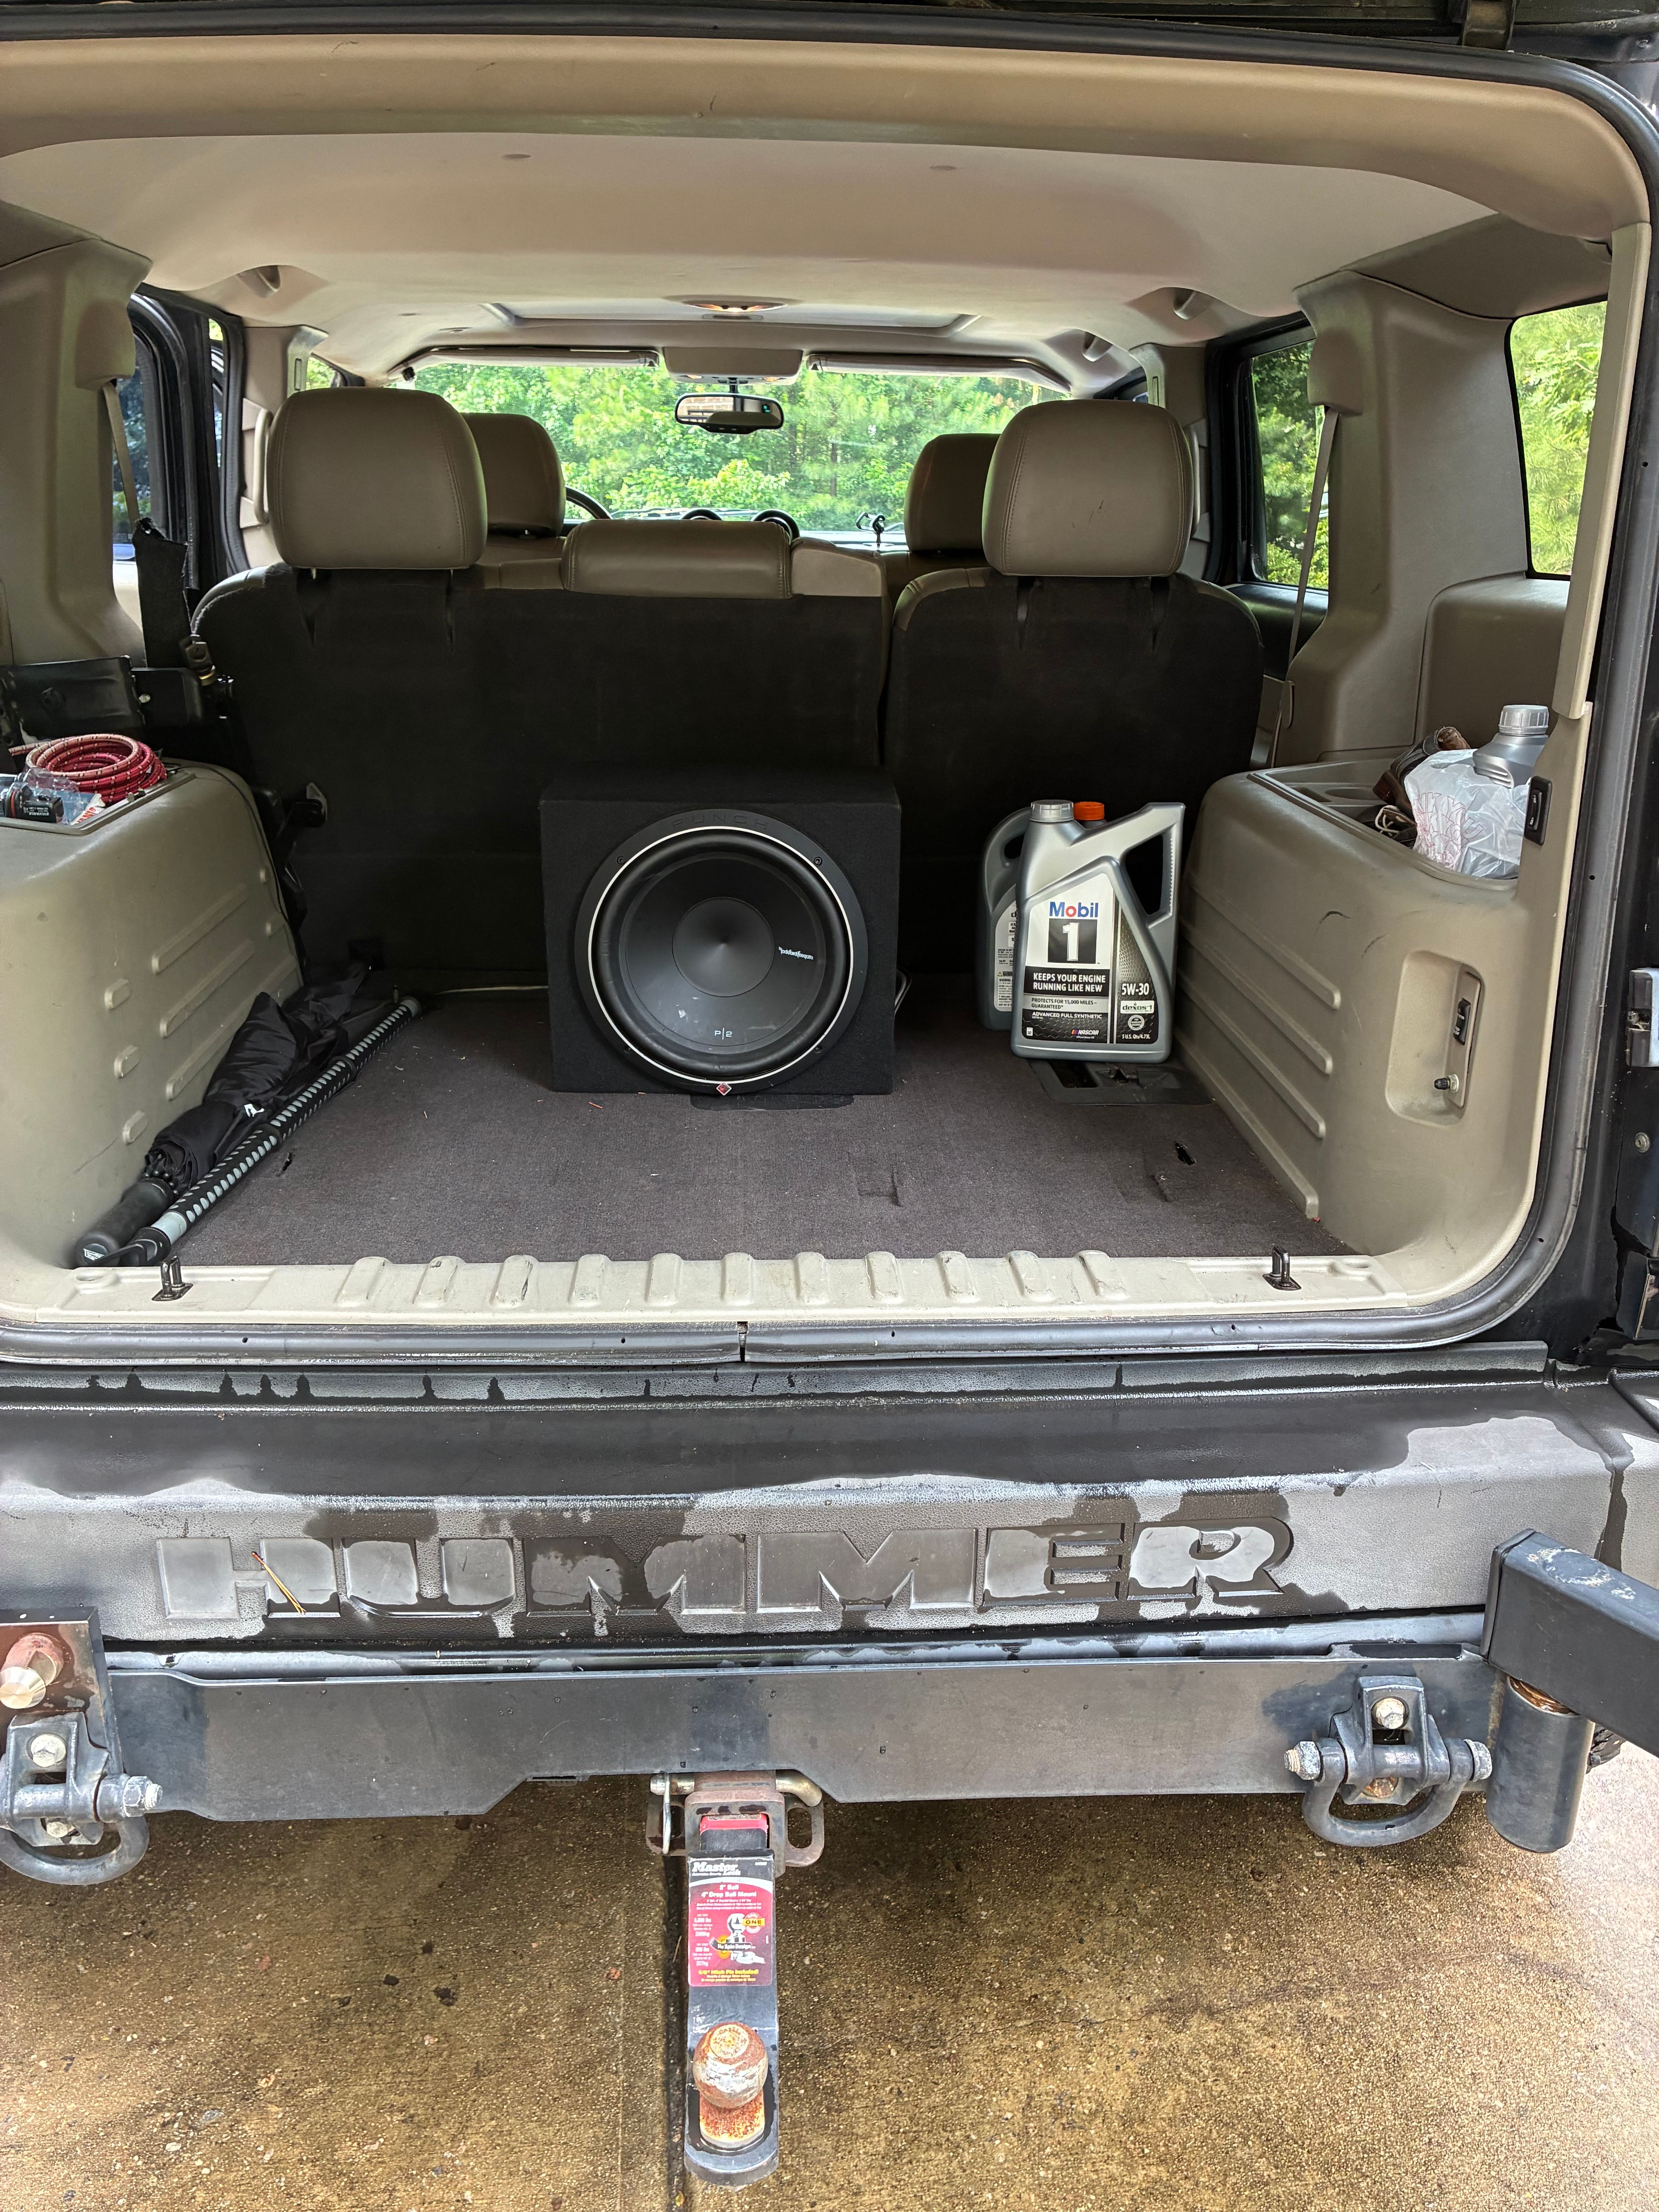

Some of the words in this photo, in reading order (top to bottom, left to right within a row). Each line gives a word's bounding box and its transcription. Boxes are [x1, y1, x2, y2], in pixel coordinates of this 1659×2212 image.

[1049, 902, 1098, 917] Mobil
[1063, 922, 1079, 961] 1
[1034, 972, 1055, 981] KEEPS
[1057, 974, 1077, 982] YOUR
[1079, 975, 1106, 983] ENGINE
[1033, 982, 1066, 991] RUNNING
[1121, 983, 1149, 995] 5W-30
[156, 1517, 1293, 1619] HUMMER
[692, 1862, 738, 1872] Master
